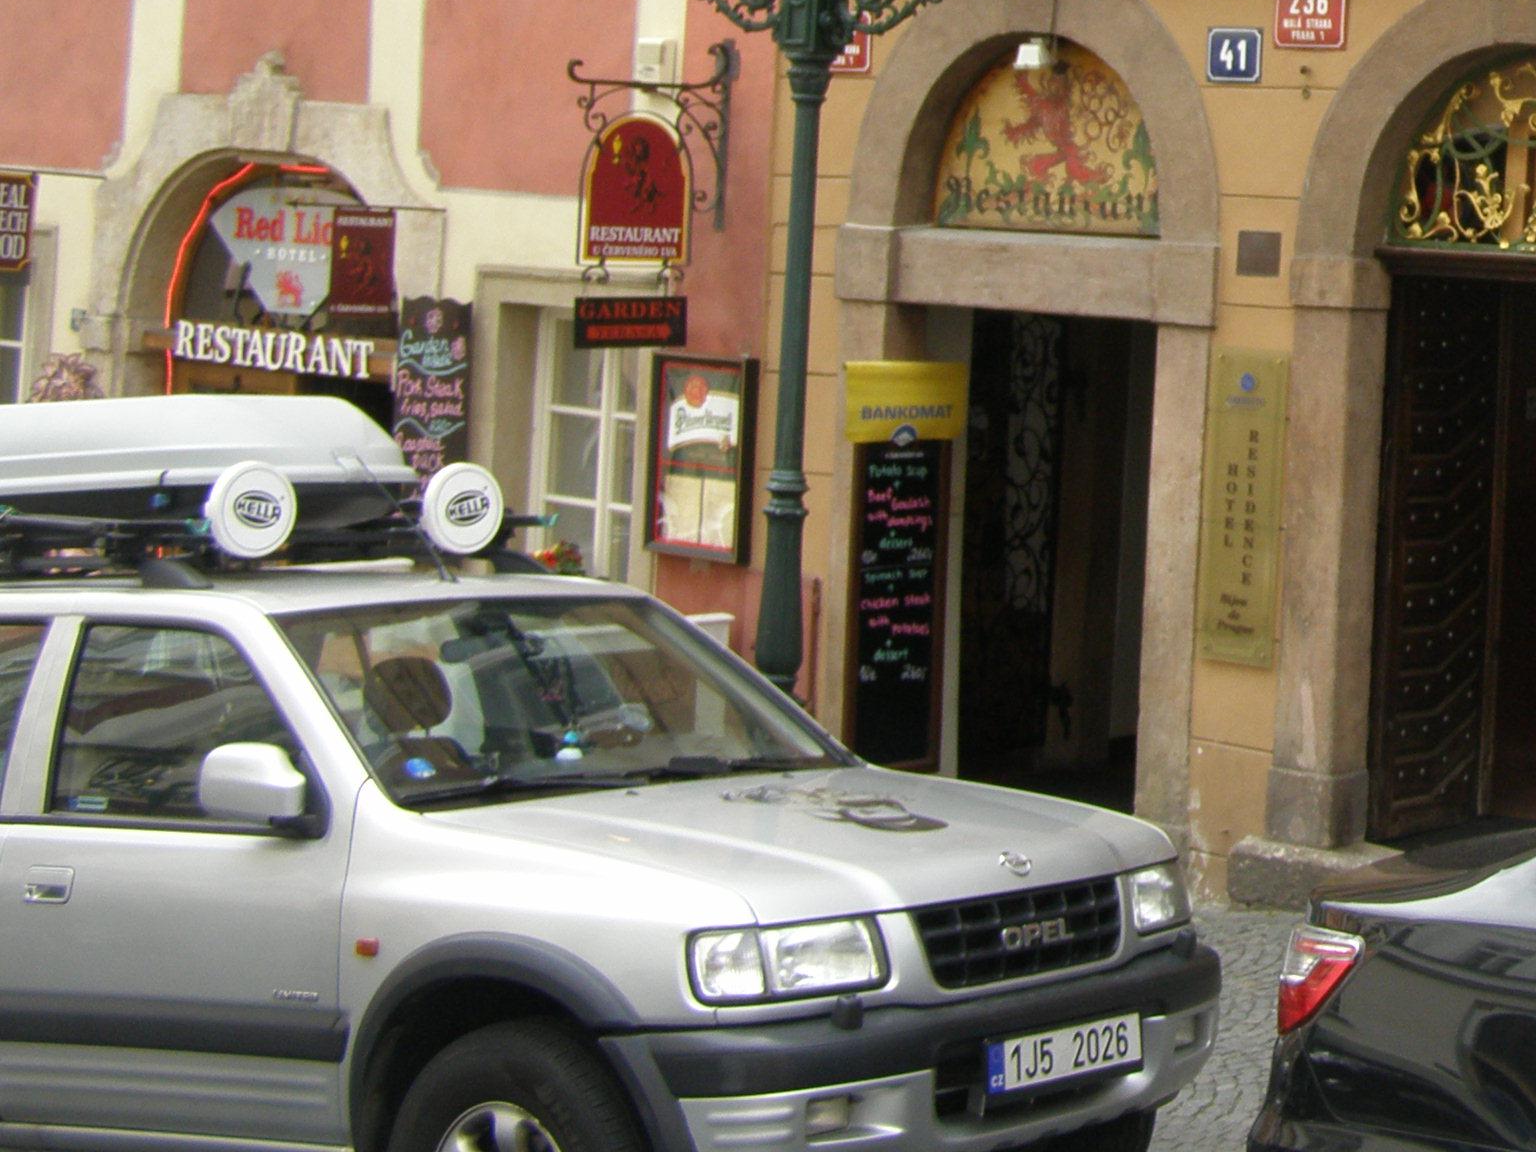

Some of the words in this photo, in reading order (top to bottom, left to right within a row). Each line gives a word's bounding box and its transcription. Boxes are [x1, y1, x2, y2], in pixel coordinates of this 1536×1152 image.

[1319, 31, 1325, 41] 1
[1219, 38, 1248, 72] 41
[233, 206, 287, 242] Red
[589, 225, 681, 244] RESTAURANT
[266, 247, 318, 264] HOTEL
[577, 301, 681, 321] GARDEN
[173, 318, 376, 380] RESTAURANT
[861, 404, 953, 421] BANKOMAT
[236, 499, 282, 521] HELLA
[449, 497, 491, 517] HELLA
[1224, 462, 1239, 548] HOTEL
[1241, 429, 1259, 586] RESIDENCE
[1001, 918, 1075, 950] OPEL
[1010, 1036, 1054, 1082] 1J5
[1072, 1020, 1129, 1069] 2026
